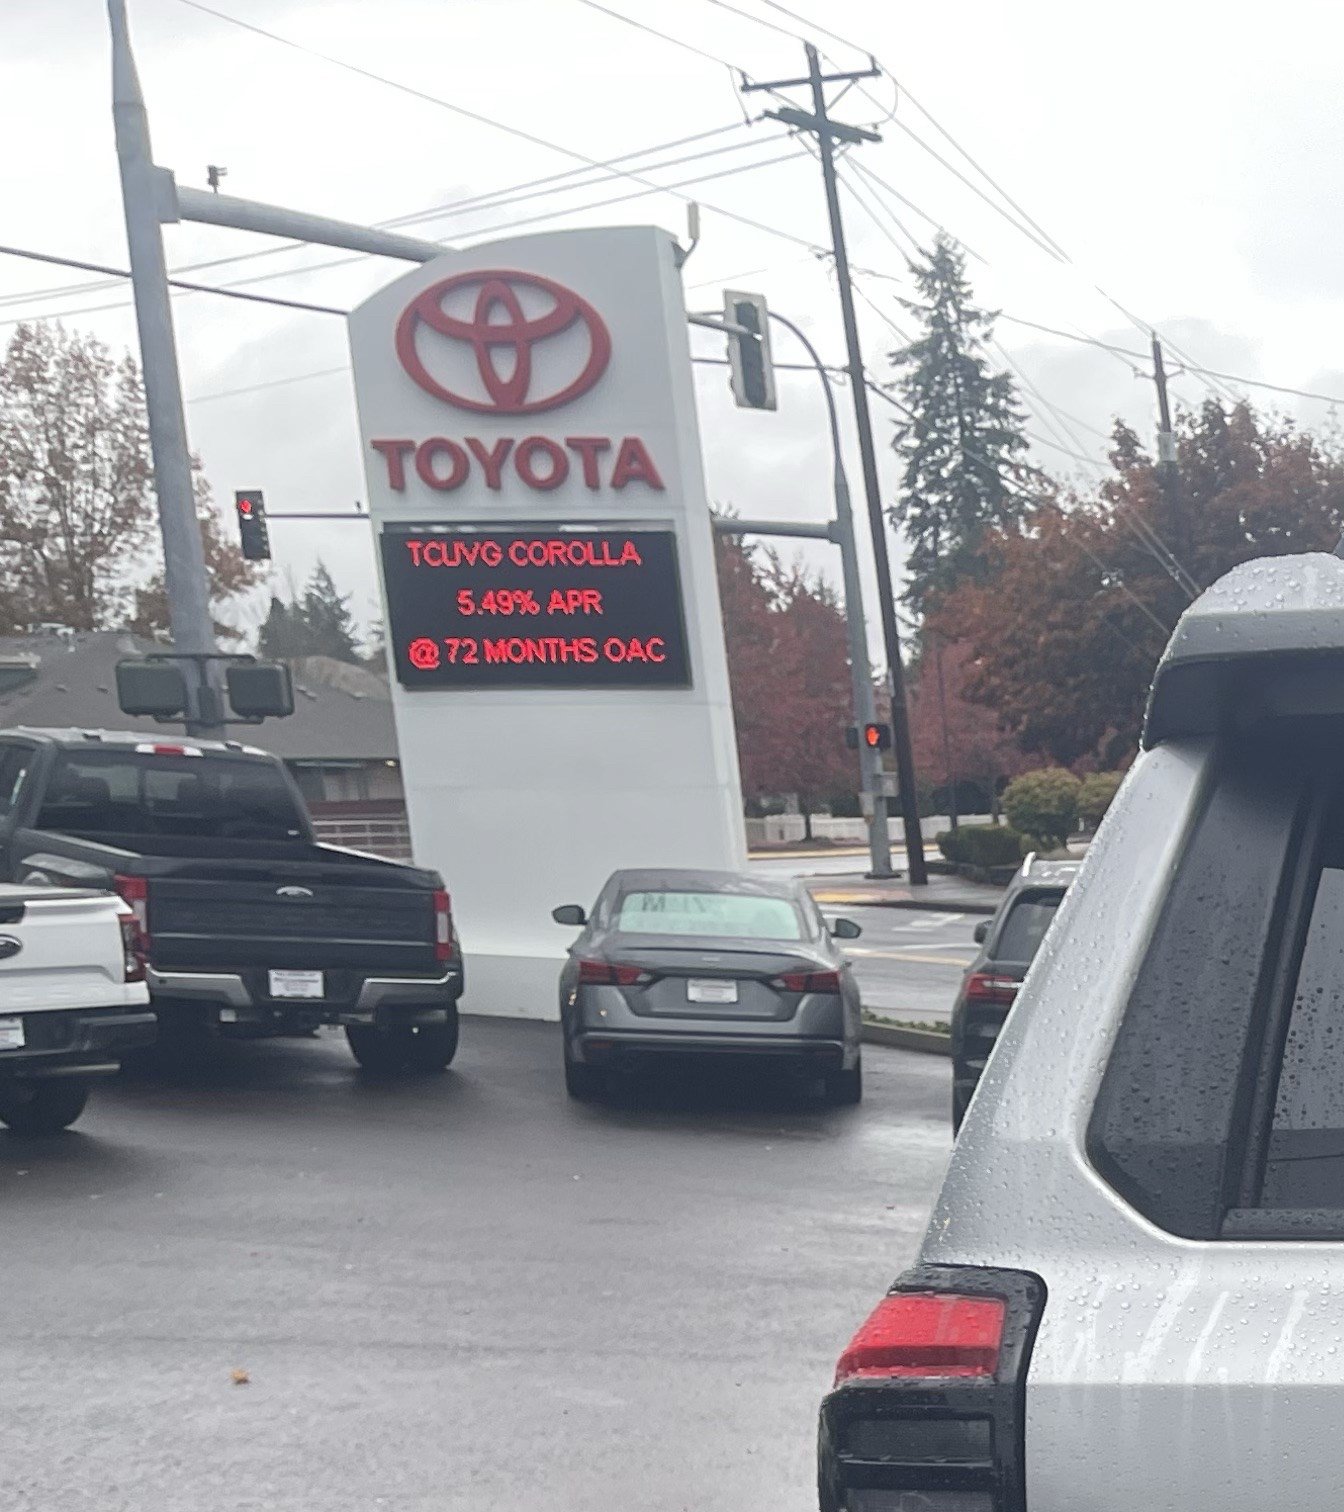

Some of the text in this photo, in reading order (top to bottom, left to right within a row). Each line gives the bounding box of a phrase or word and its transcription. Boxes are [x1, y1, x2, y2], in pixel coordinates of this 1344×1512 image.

[370, 436, 665, 491] TOYOTA
[508, 540, 642, 566] COROLLA
[456, 588, 603, 616] 5.49% APR
[408, 637, 666, 670] @ 72 MONTHS OAC
